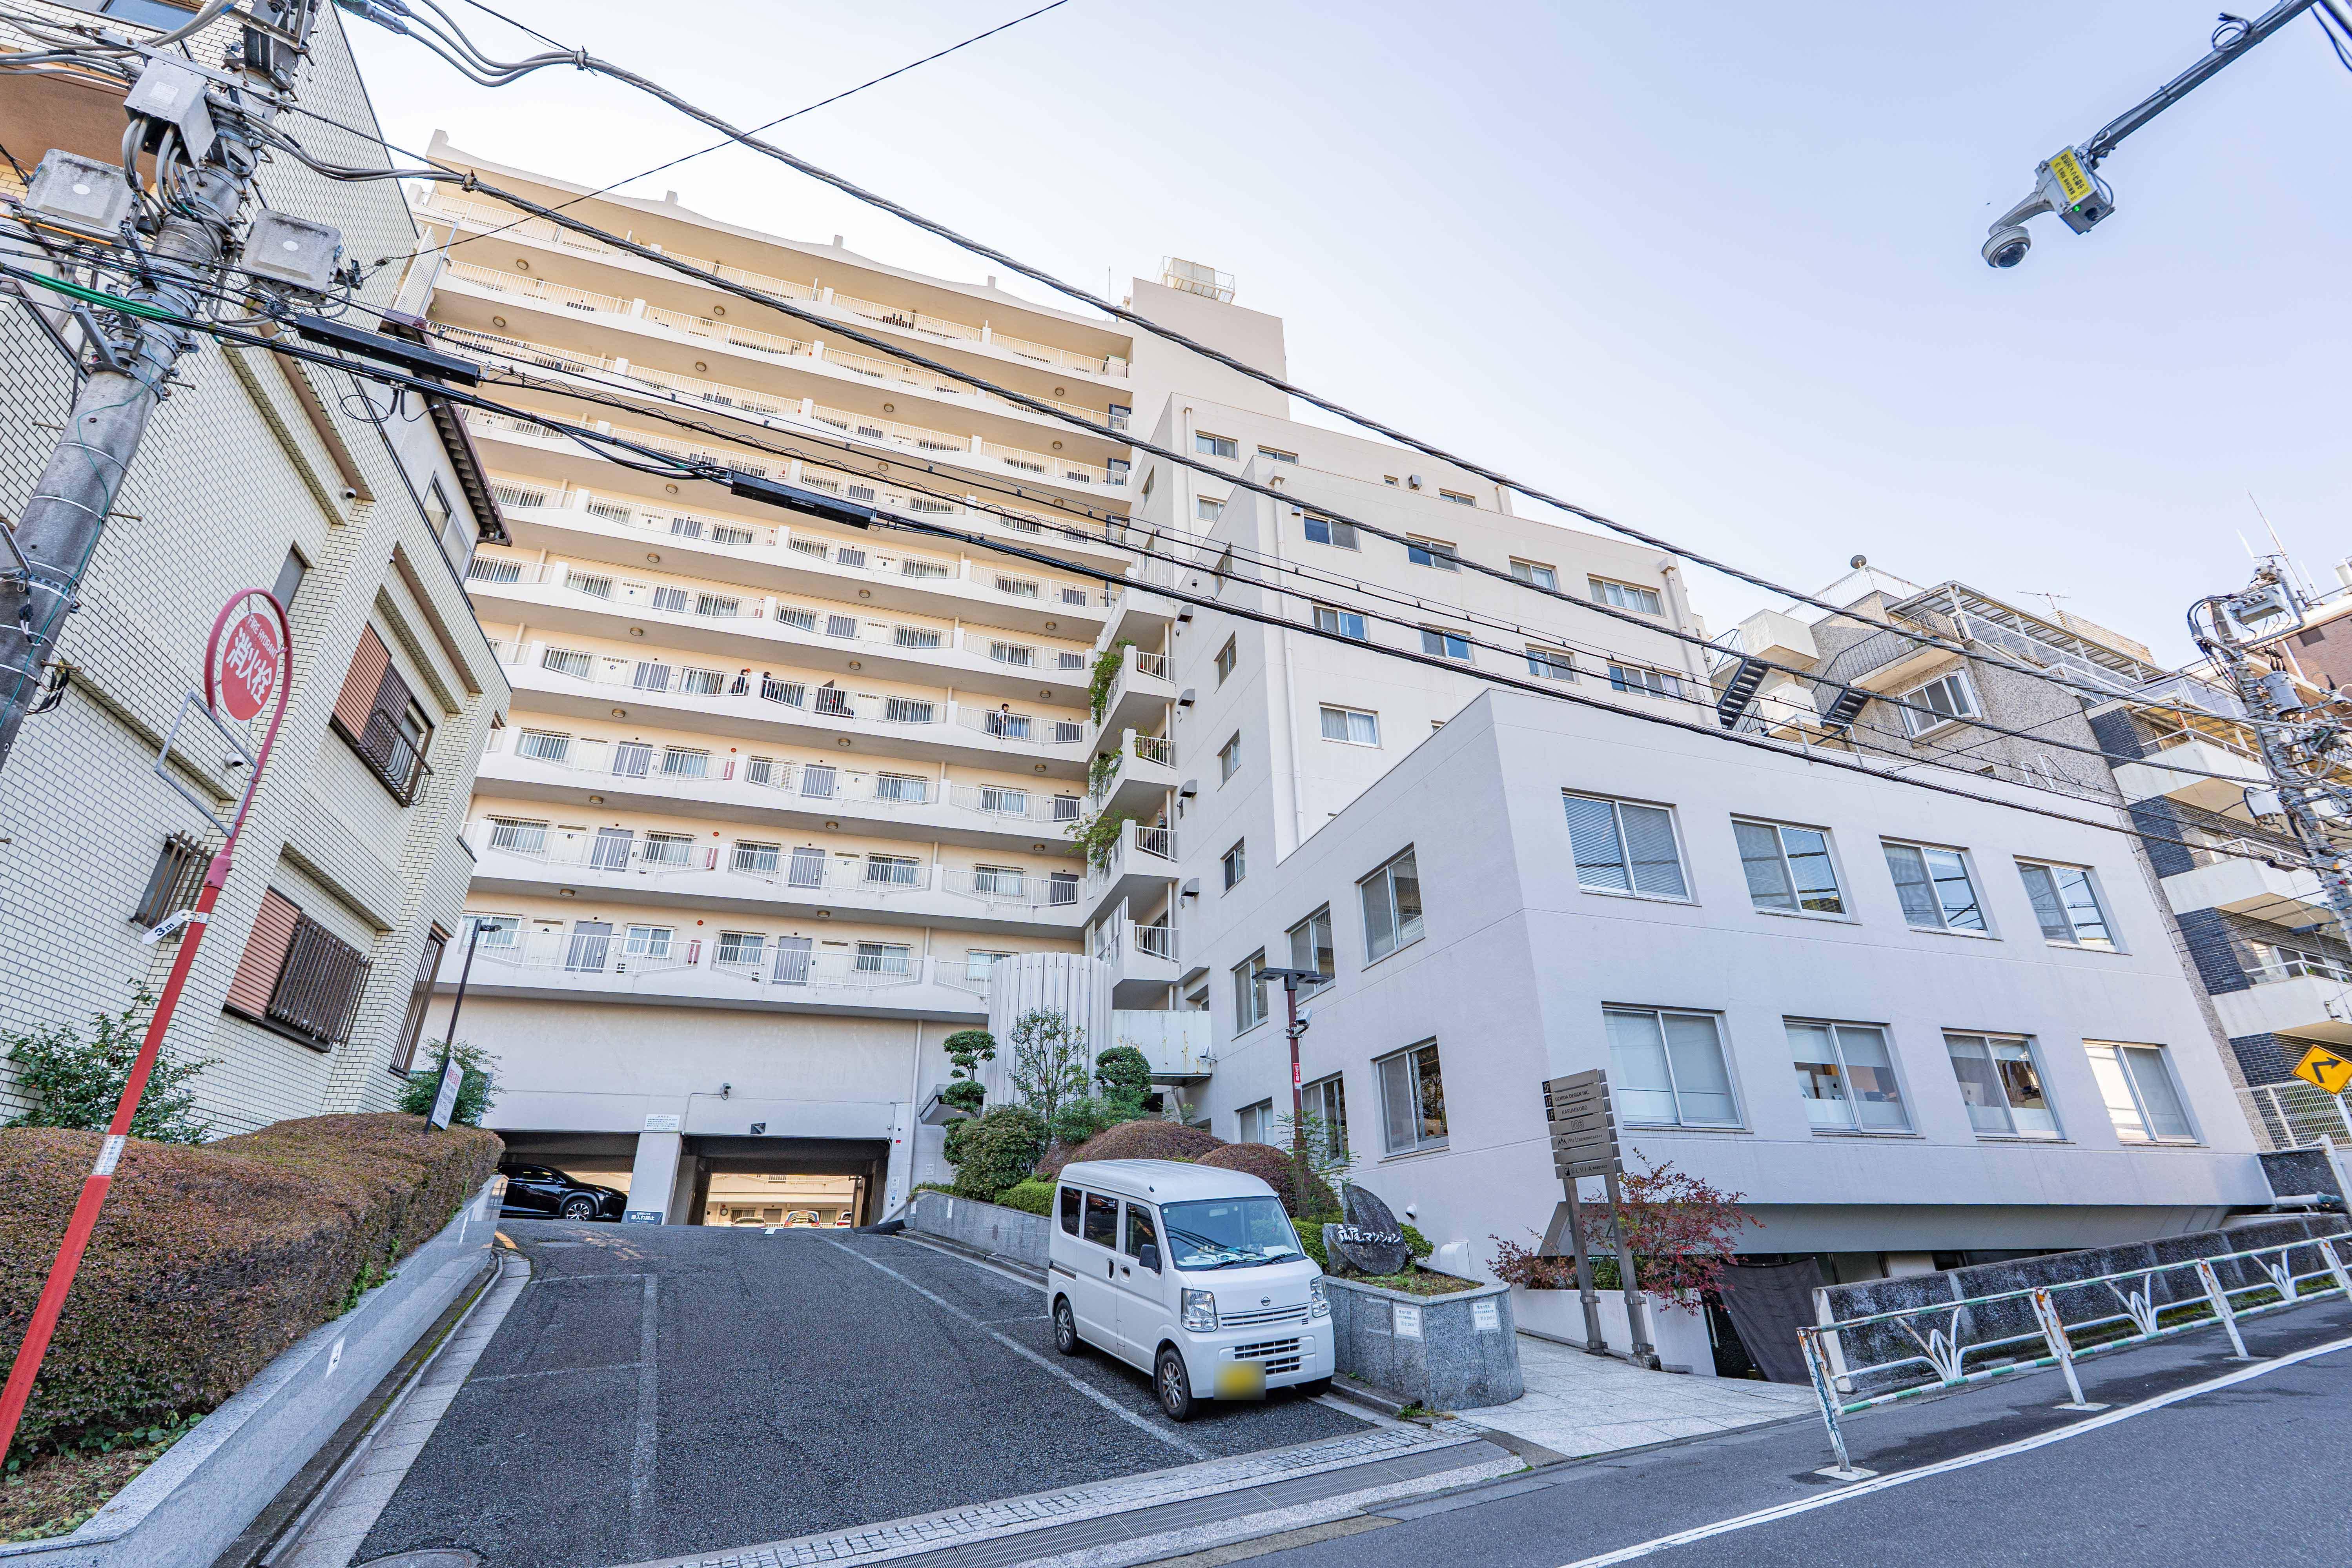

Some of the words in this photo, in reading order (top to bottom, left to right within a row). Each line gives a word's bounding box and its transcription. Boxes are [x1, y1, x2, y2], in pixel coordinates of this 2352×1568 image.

[248, 614, 261, 634] FIRE
[257, 628, 278, 659] HYDRANT
[226, 627, 272, 705] 消火栓
[1544, 1082, 1550, 1092] 2F
[1546, 1096, 1552, 1106] 1F
[1548, 1110, 1554, 1120] 1F
[1561, 1105, 1588, 1115] KASUMIKOBO
[1570, 1119, 1585, 1130] 103
